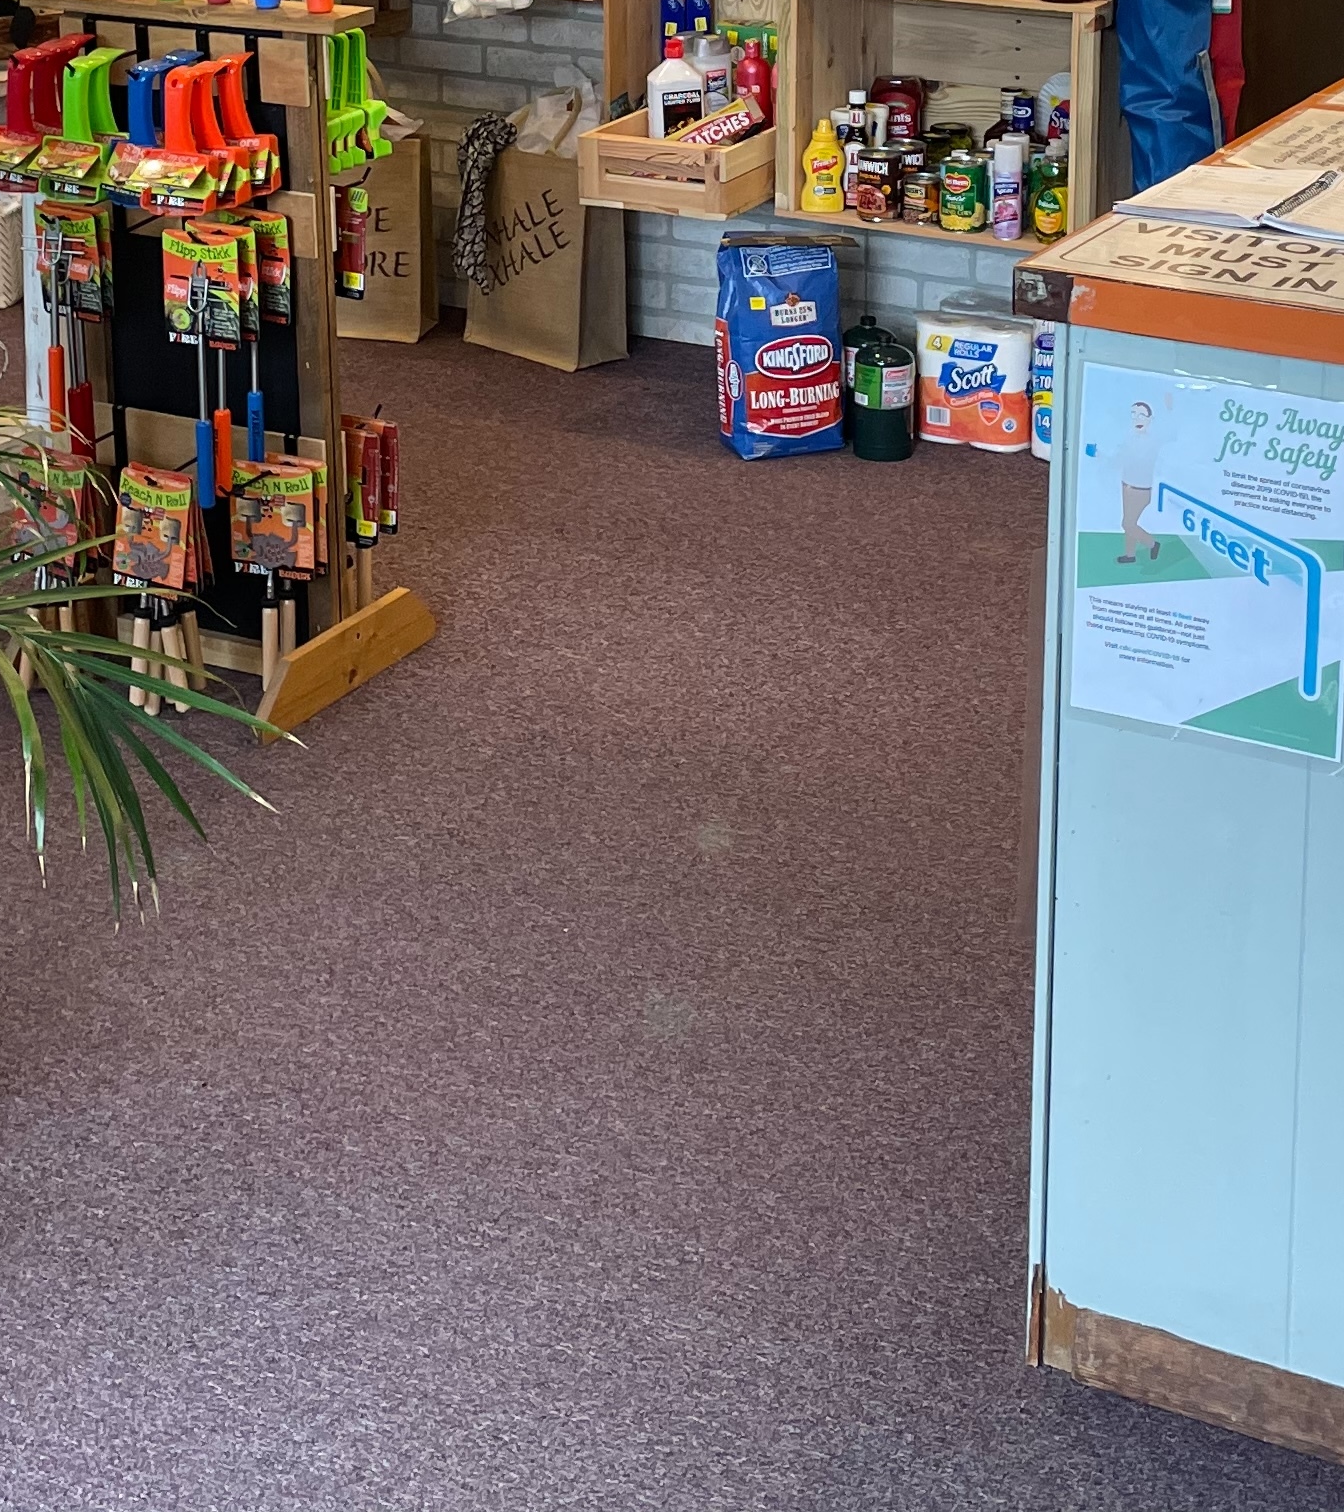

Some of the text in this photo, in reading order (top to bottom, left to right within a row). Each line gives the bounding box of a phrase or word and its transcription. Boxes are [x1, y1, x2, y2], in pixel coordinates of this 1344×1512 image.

[663, 91, 701, 100] CHARCOAL
[168, 238, 233, 261] Flipp Stikk
[1157, 243, 1335, 274] MUST
[1109, 254, 1340, 293] SIGN IN
[774, 307, 798, 317] BURNS
[780, 313, 807, 324] LONGER
[931, 336, 942, 350] 4
[953, 348, 981, 359] ROLLS
[954, 342, 993, 354] REGULAR
[762, 342, 829, 372] KINGSFORD
[947, 363, 997, 393] Scott
[750, 380, 841, 410] LONG-BURNING
[1218, 398, 1269, 438] Step
[1213, 430, 1338, 481] for Safety
[120, 475, 189, 509] Reach N Roll
[273, 476, 312, 494] N Roll
[1221, 489, 1261, 500] government
[1259, 477, 1282, 487] spread
[1291, 483, 1331, 495] coronavirus
[1182, 509, 1272, 586] 6 feet
